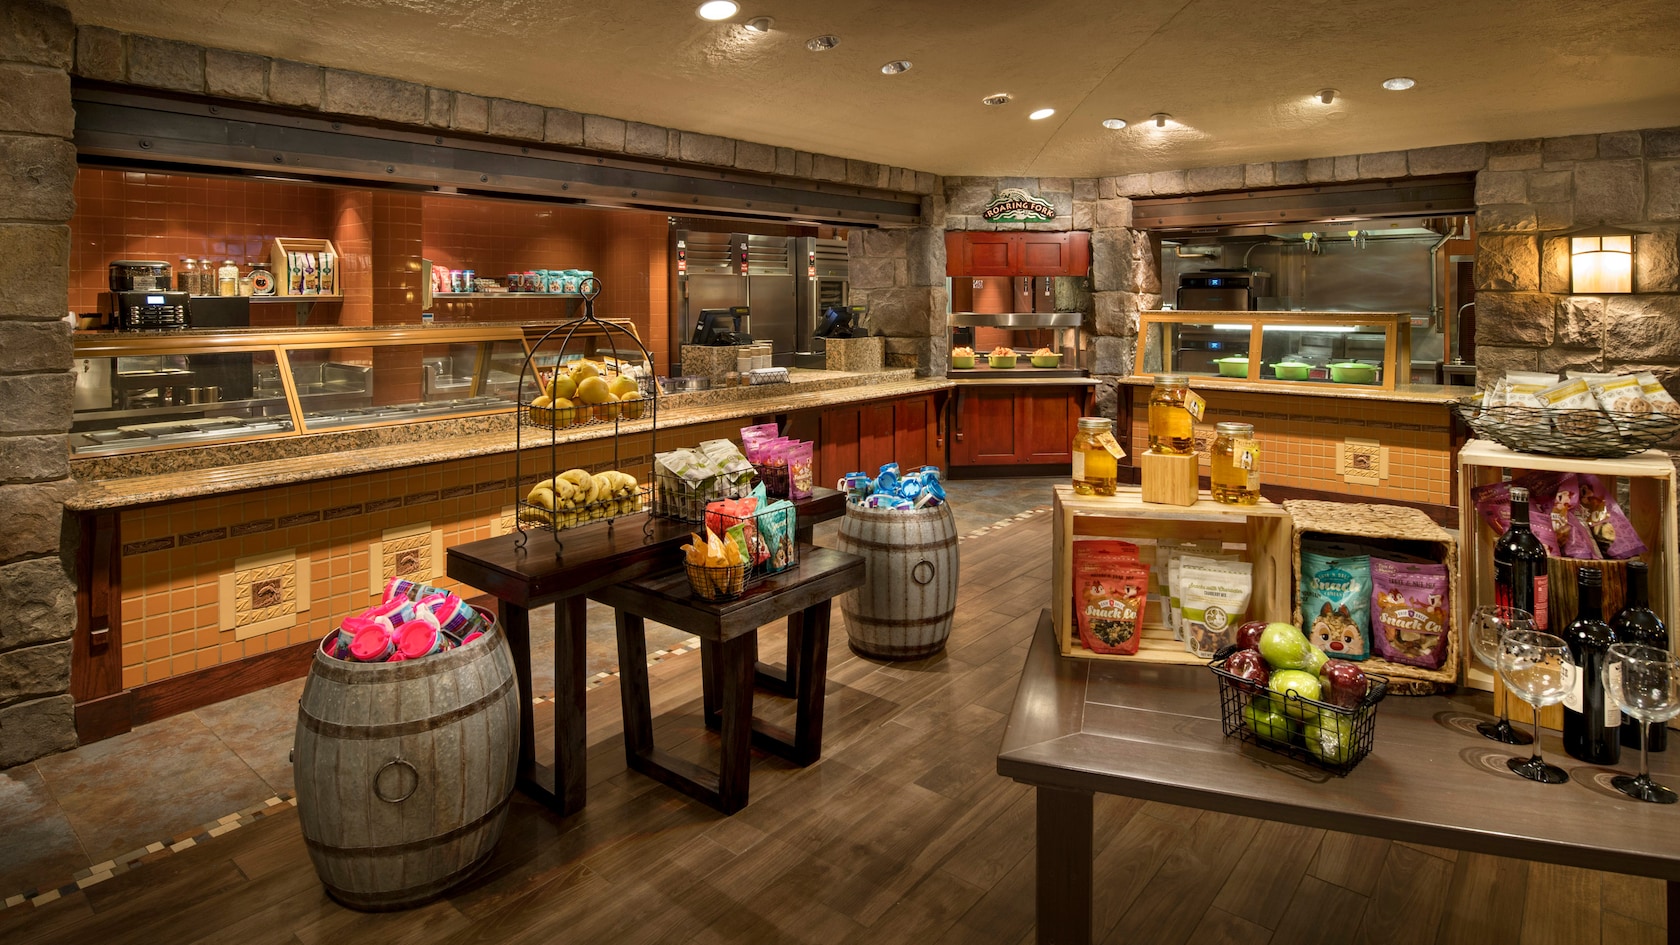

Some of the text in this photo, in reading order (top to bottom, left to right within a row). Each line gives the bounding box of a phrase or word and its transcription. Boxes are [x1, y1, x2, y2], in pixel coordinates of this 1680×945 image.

[987, 201, 1053, 217] ROARING FORK
[1084, 605, 1122, 619] Snack
[1380, 612, 1423, 630] Snack
